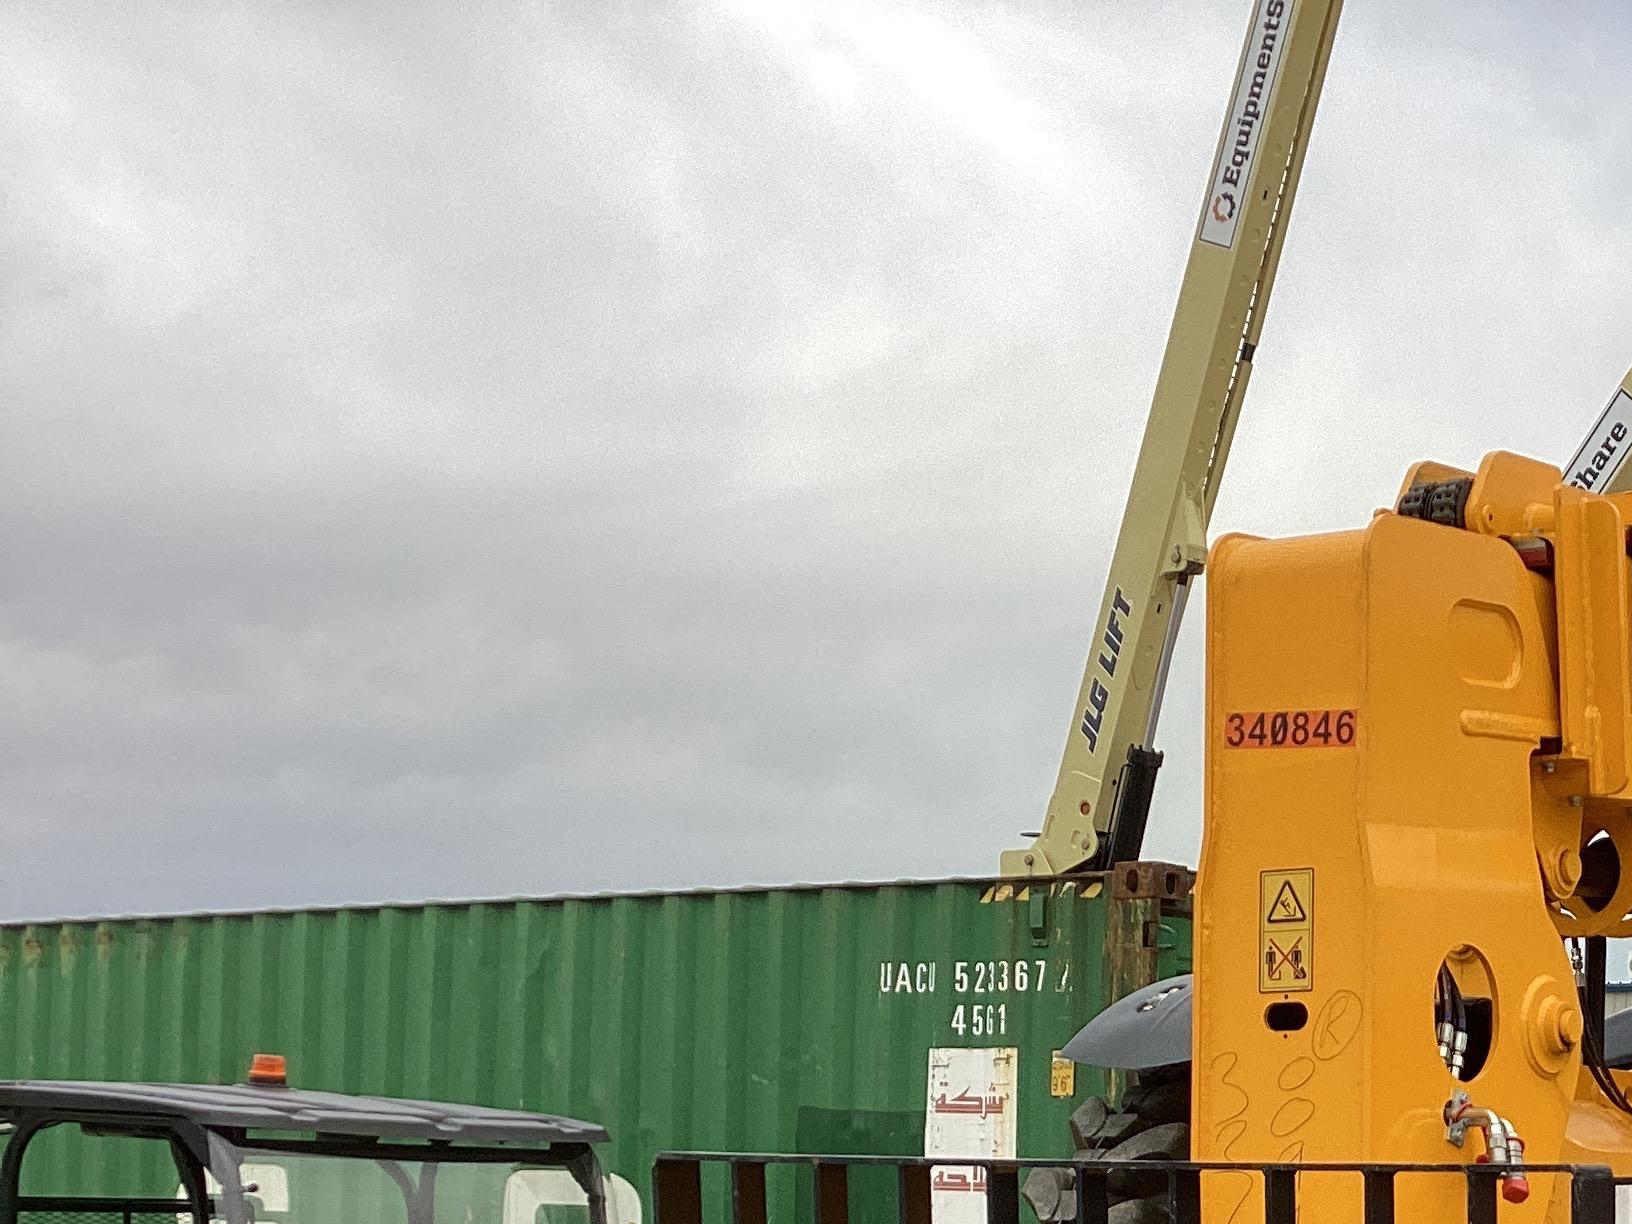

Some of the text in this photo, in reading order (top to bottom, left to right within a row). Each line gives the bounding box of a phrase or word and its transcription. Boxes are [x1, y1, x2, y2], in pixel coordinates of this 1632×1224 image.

[1081, 585, 1131, 754] JLG LIFT
[1226, 710, 1355, 748] 340846
[879, 961, 937, 993] UACU
